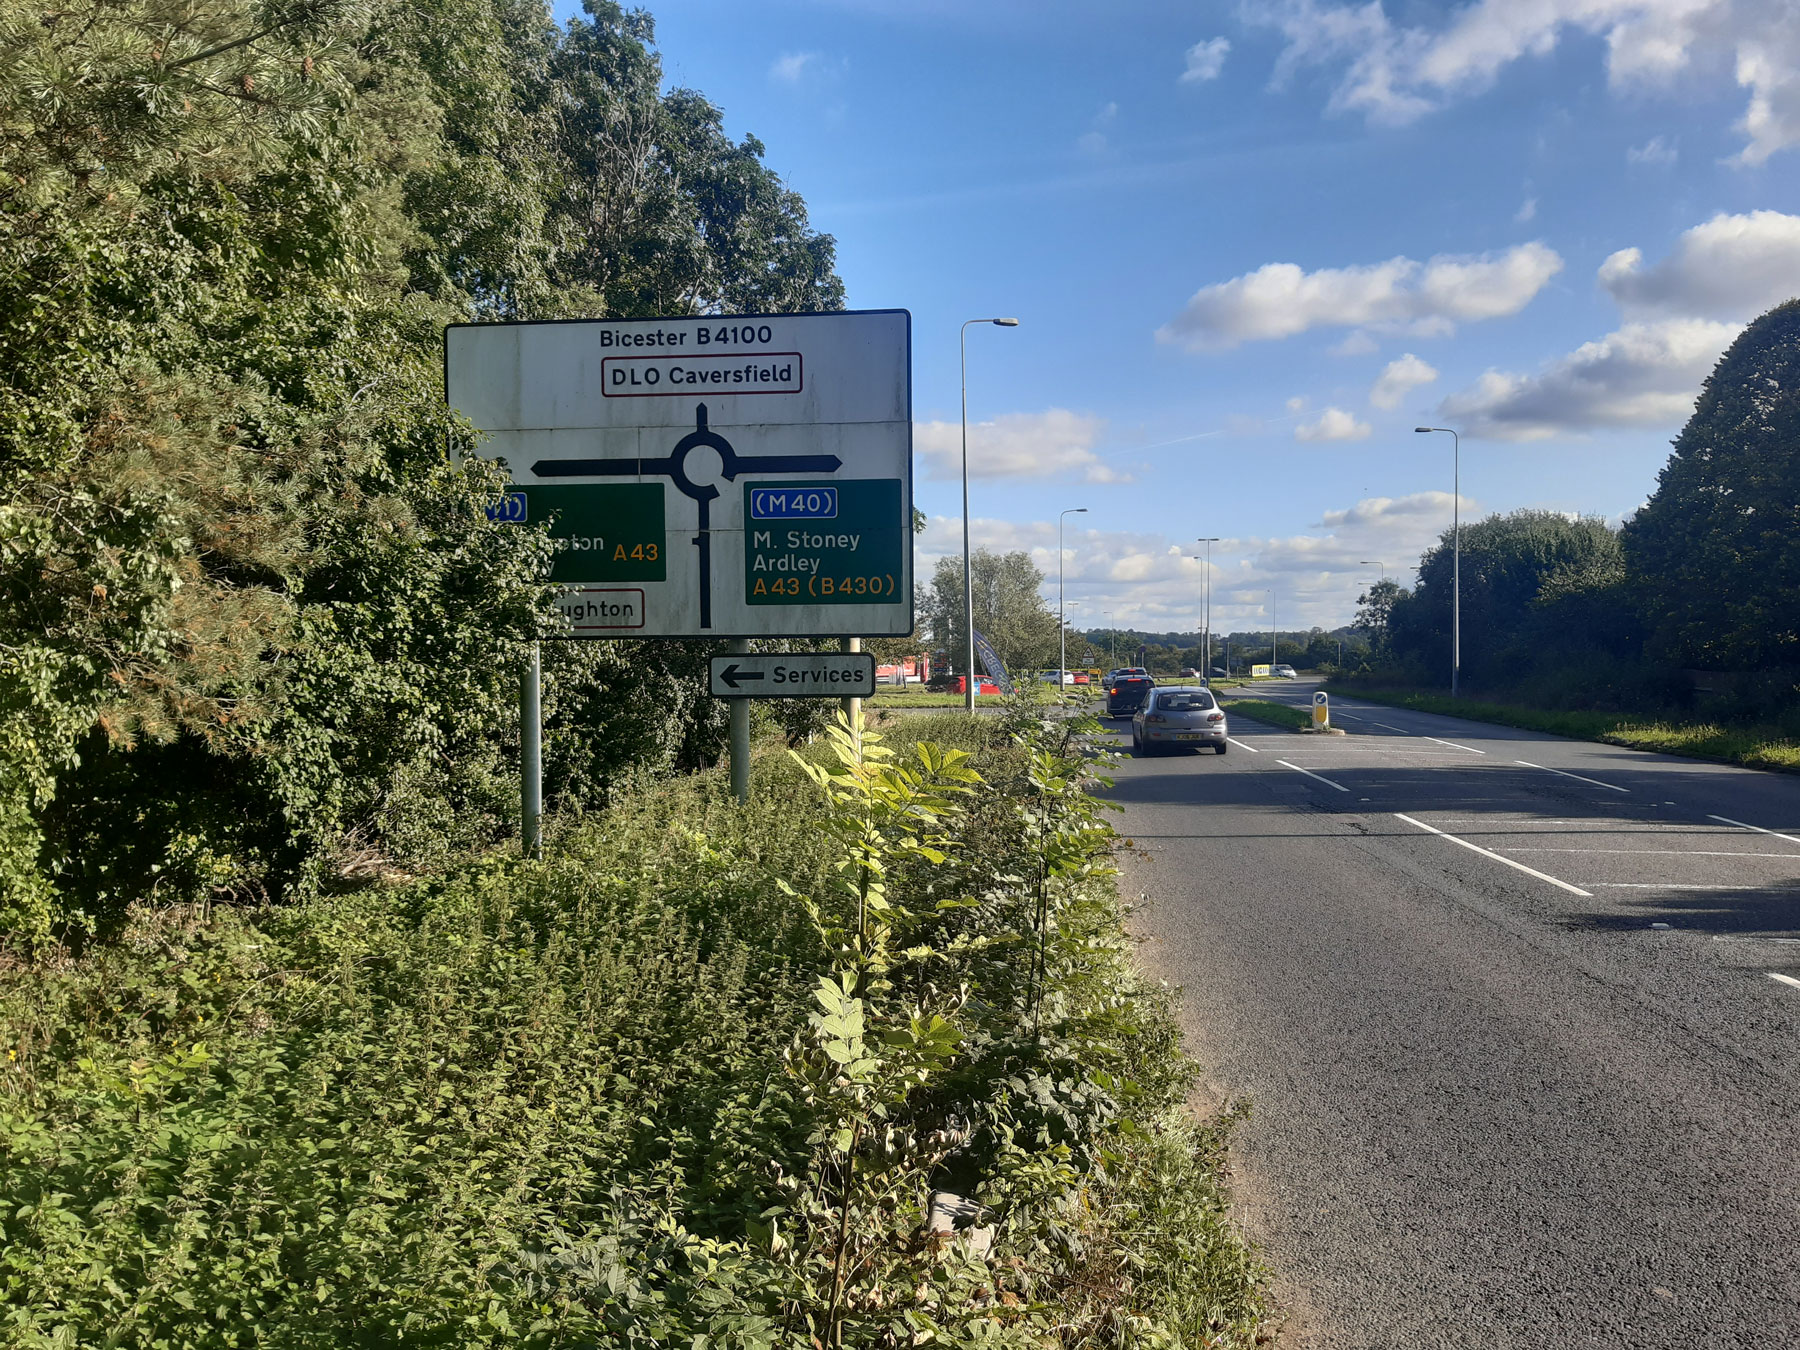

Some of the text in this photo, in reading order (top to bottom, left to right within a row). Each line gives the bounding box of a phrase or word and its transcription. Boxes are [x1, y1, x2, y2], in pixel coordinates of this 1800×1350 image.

[600, 329, 687, 348] Bicester
[612, 363, 793, 386] DLO Caversfield
[753, 530, 861, 552] M. Stoney
[752, 553, 821, 575] Ardley
[560, 600, 634, 621] ughton
[772, 665, 865, 685] Services
